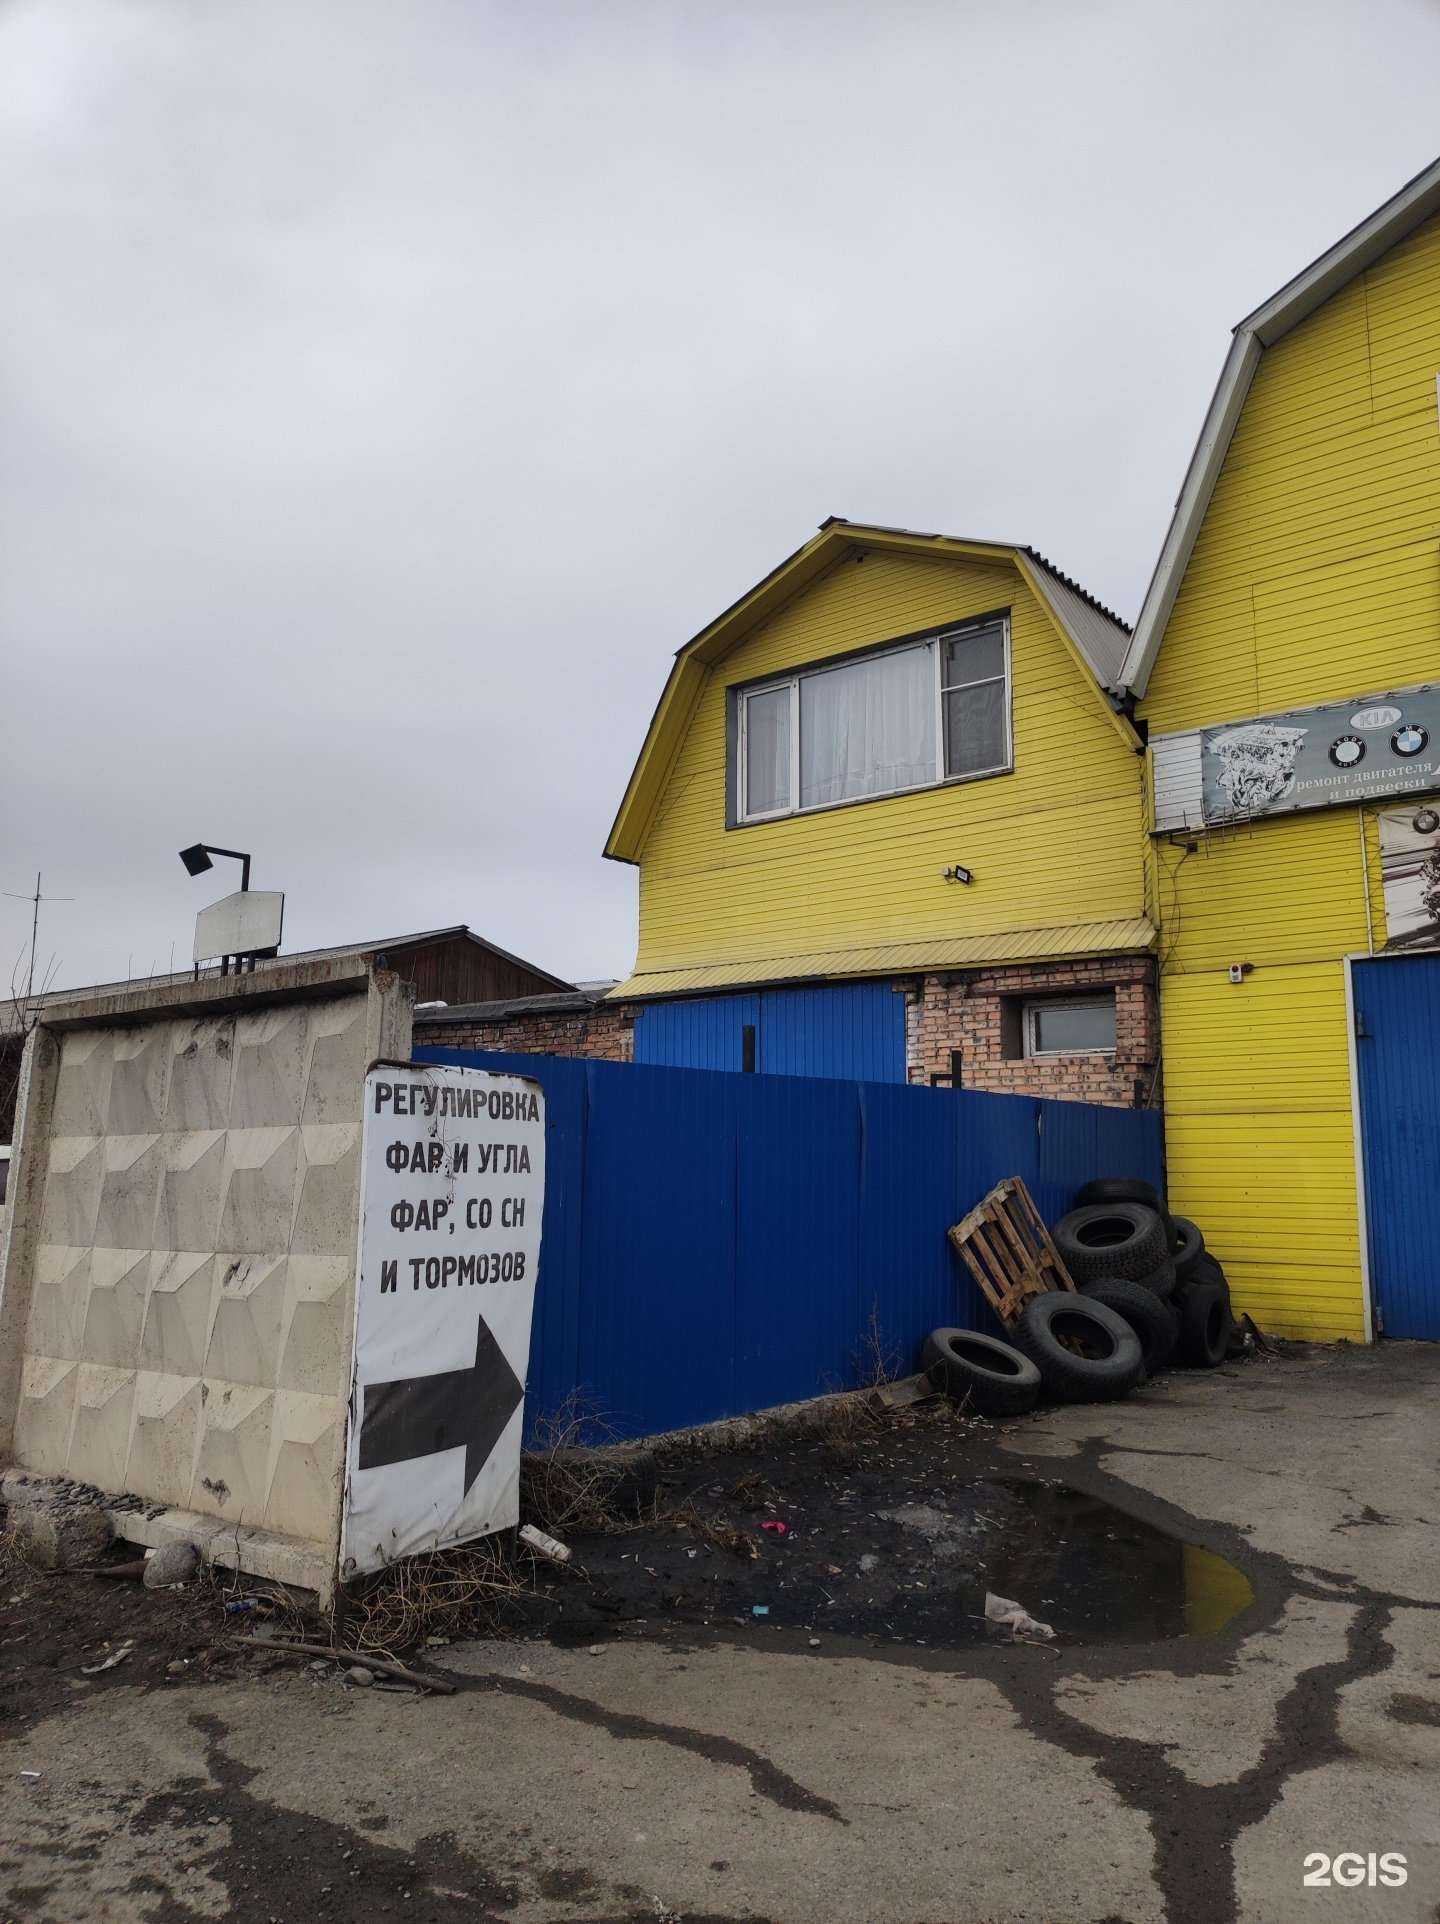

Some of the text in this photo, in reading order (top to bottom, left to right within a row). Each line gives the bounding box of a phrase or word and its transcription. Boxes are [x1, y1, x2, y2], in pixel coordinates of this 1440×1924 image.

[1360, 709, 1394, 728] KIA
[1392, 725, 1424, 738] BMW
[1296, 762, 1433, 793] ремонт двигателя
[1329, 778, 1425, 800] и подвески
[374, 1082, 540, 1122] РЕГУЛИРОВКА
[386, 1140, 531, 1174] ФАР И УГЛА
[391, 1198, 525, 1235] ФАР, СО СН
[380, 1252, 526, 1293] И ТОРМОЗОВ
